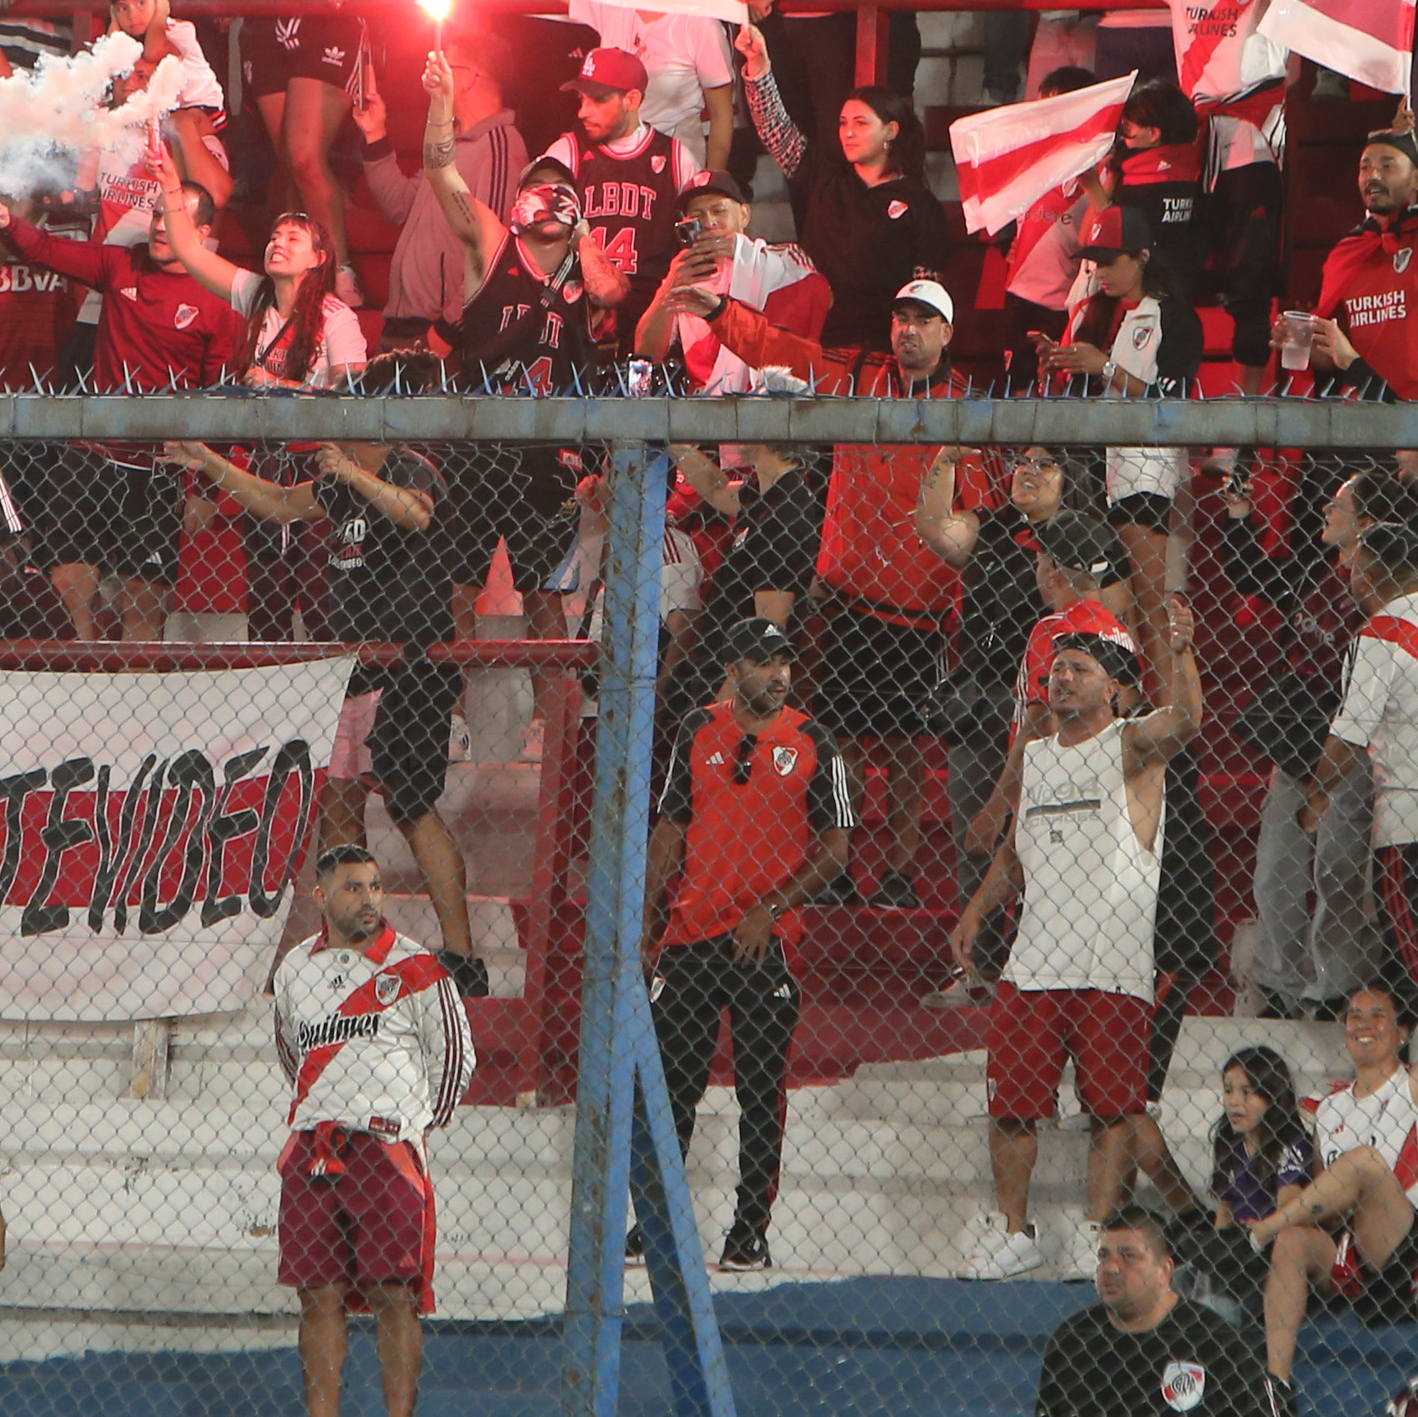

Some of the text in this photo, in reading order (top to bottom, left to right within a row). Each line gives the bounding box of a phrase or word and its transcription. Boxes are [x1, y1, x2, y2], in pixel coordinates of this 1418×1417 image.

[1185, 4, 1240, 24] TURKISH
[583, 181, 657, 222] LBDT
[1345, 289, 1407, 314] TURKISH
[1349, 305, 1408, 330] AIRLINES
